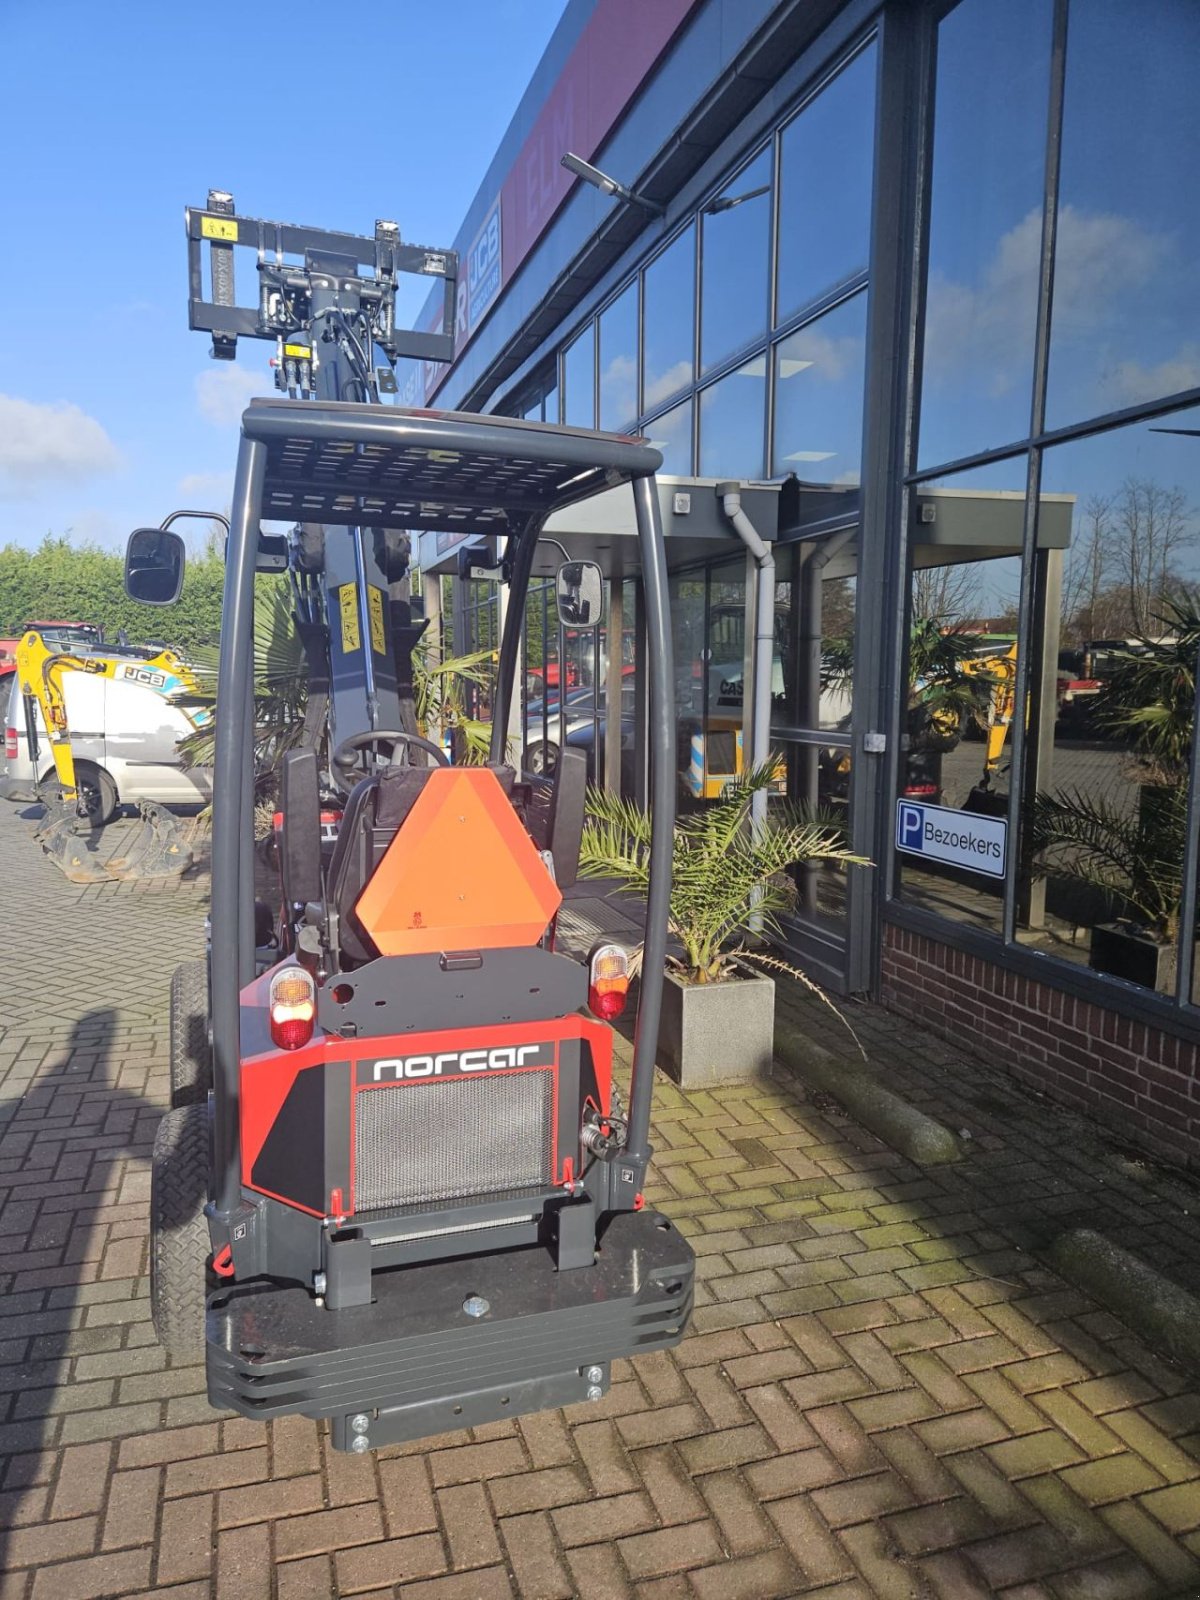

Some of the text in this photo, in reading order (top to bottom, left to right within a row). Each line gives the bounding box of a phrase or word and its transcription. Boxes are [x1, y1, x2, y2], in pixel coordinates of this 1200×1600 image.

[471, 214, 498, 292] JCB
[126, 668, 164, 686] JCB
[720, 679, 744, 695] CAS
[902, 807, 1001, 858] P Bezoekers
[373, 1045, 539, 1081] norcar
